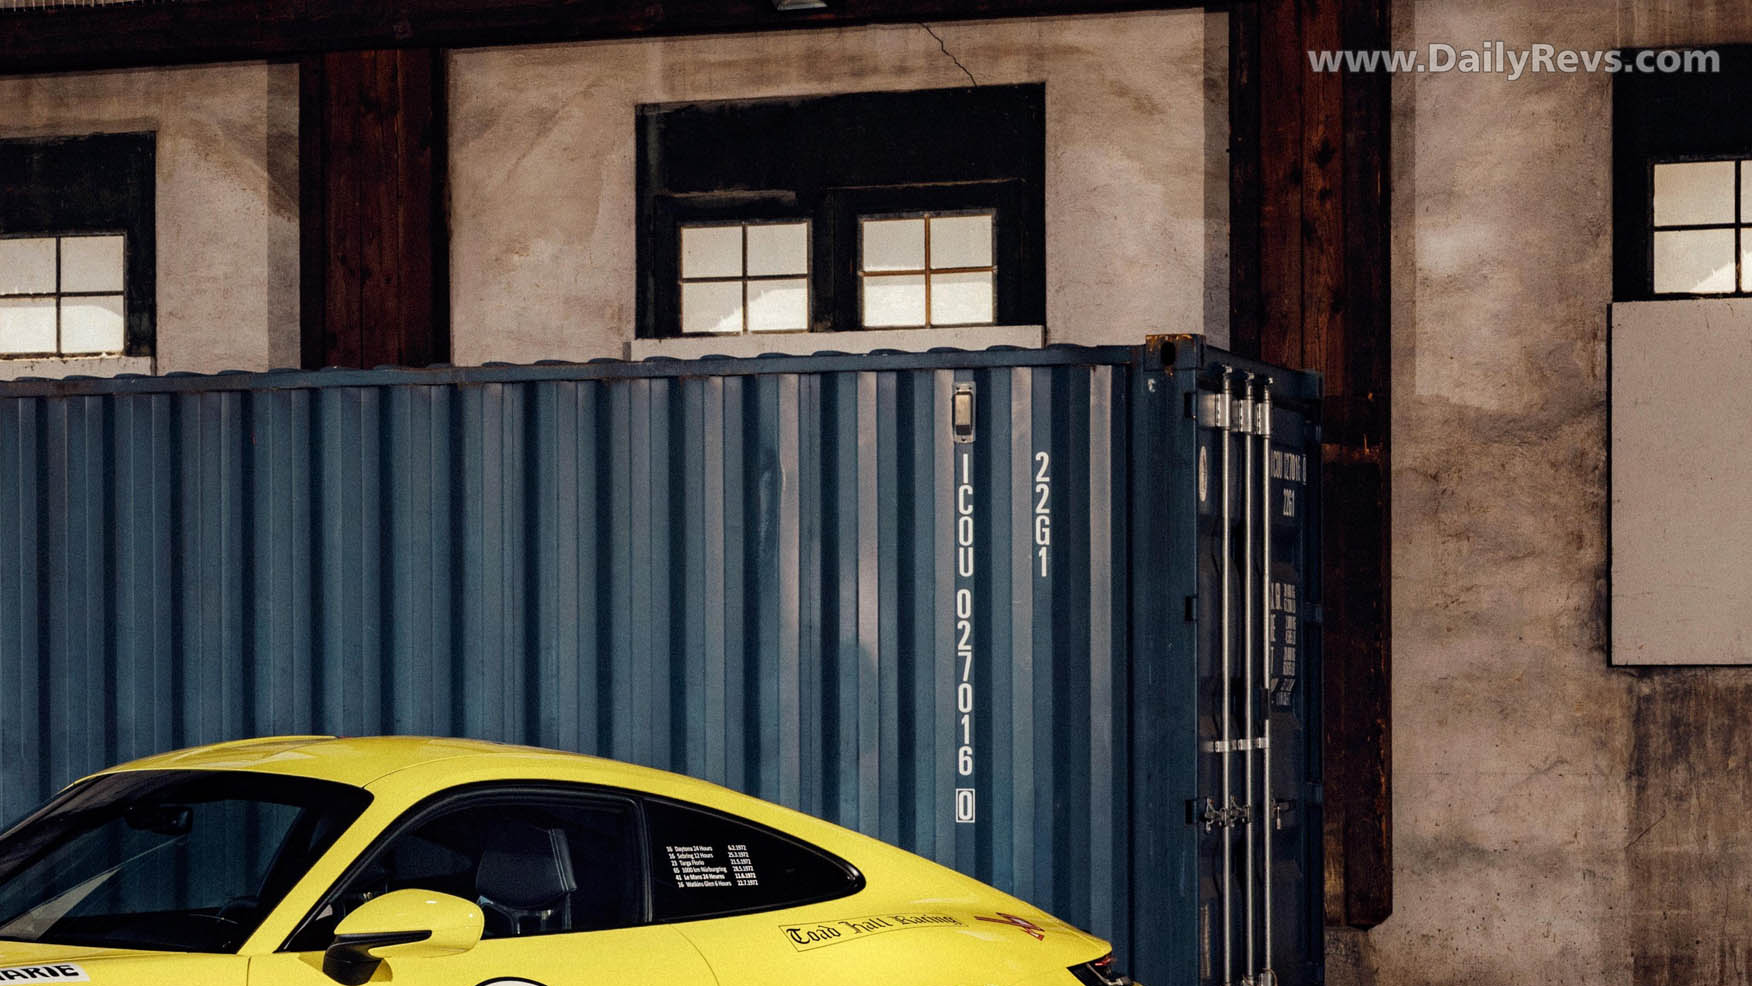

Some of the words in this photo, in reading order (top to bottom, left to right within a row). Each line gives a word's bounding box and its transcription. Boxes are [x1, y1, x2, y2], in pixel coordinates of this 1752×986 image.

[958, 453, 974, 577] ICOU
[1035, 451, 1050, 577] 22G1
[956, 588, 973, 776] 027016
[957, 790, 973, 822] 0
[786, 925, 841, 945] Toad
[889, 914, 962, 926] Racing
